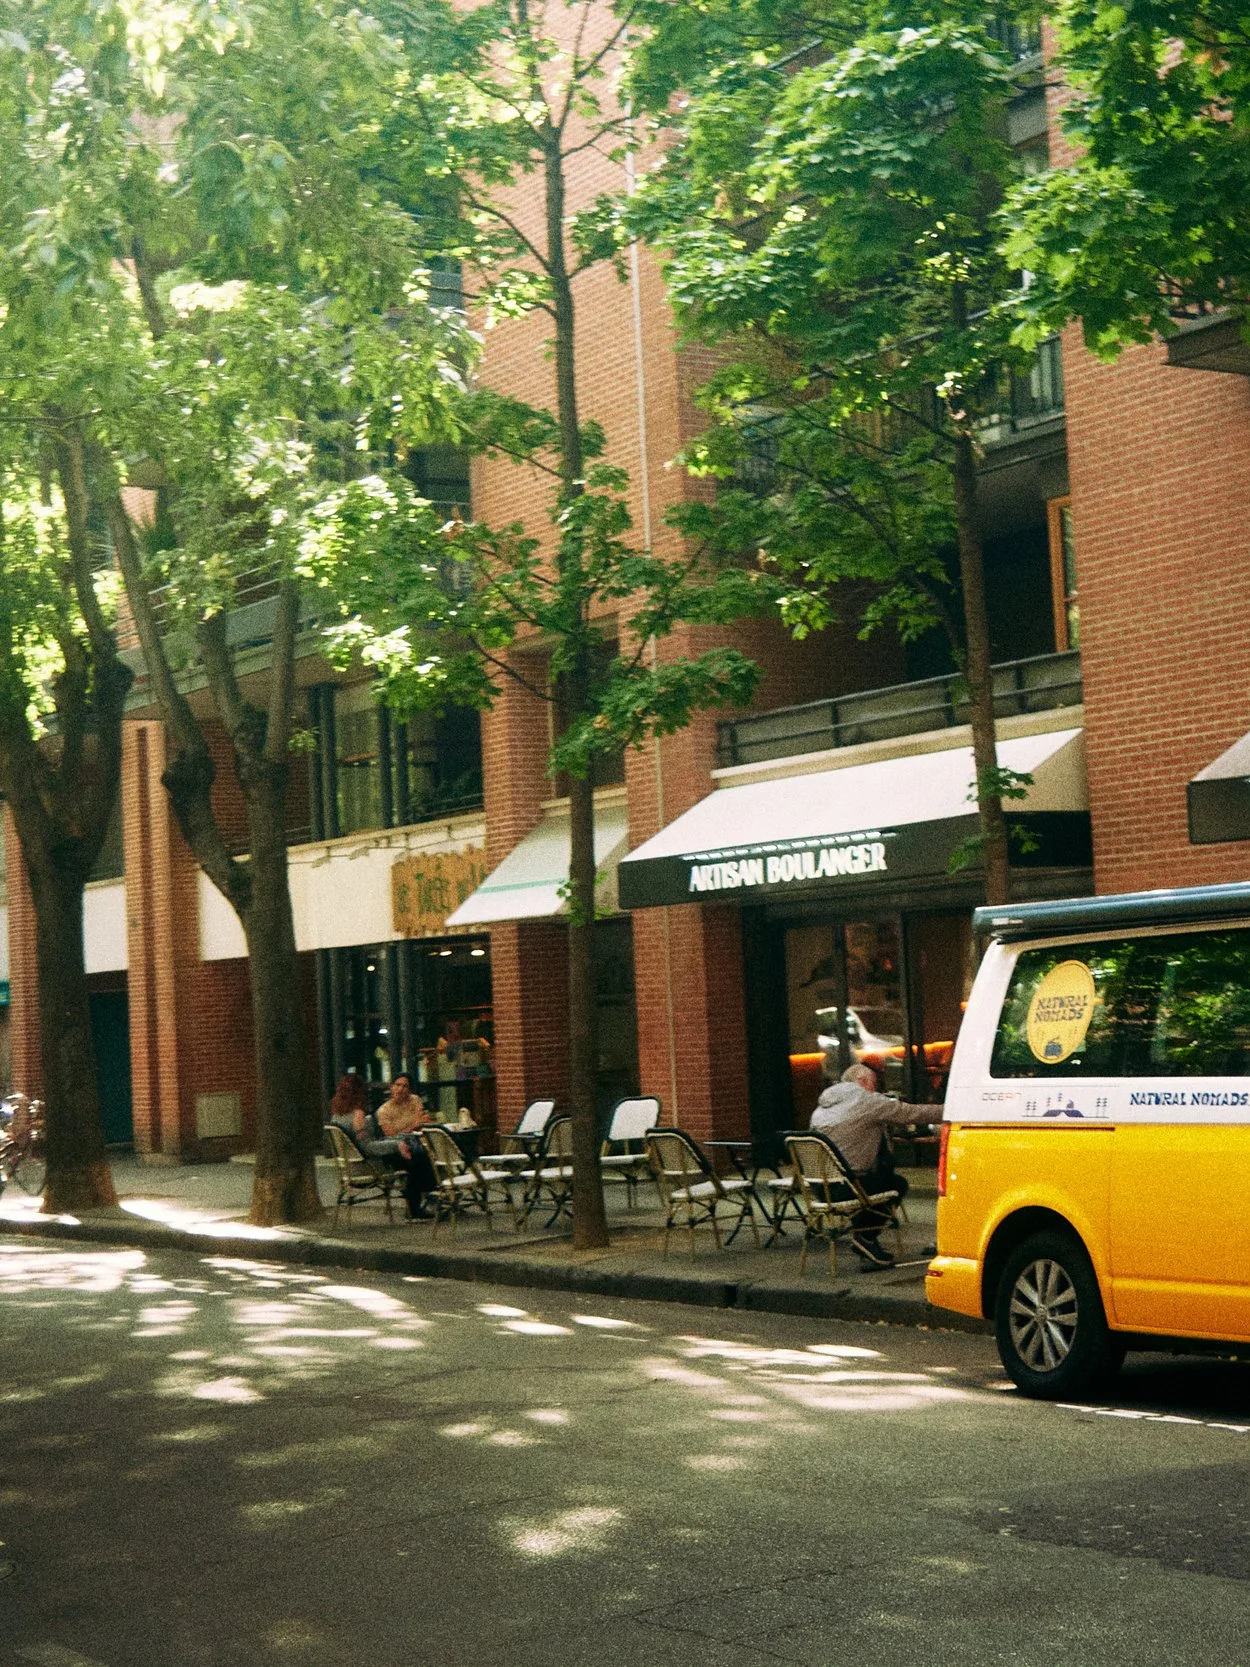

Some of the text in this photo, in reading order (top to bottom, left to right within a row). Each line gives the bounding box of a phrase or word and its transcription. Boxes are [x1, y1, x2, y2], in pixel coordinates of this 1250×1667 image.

[689, 843, 888, 892] ARTISAN BOULANGER
[1036, 994, 1088, 1010] NATURAL
[1034, 1008, 1084, 1023] NOMADS
[1129, 1092, 1187, 1106] NATURAL
